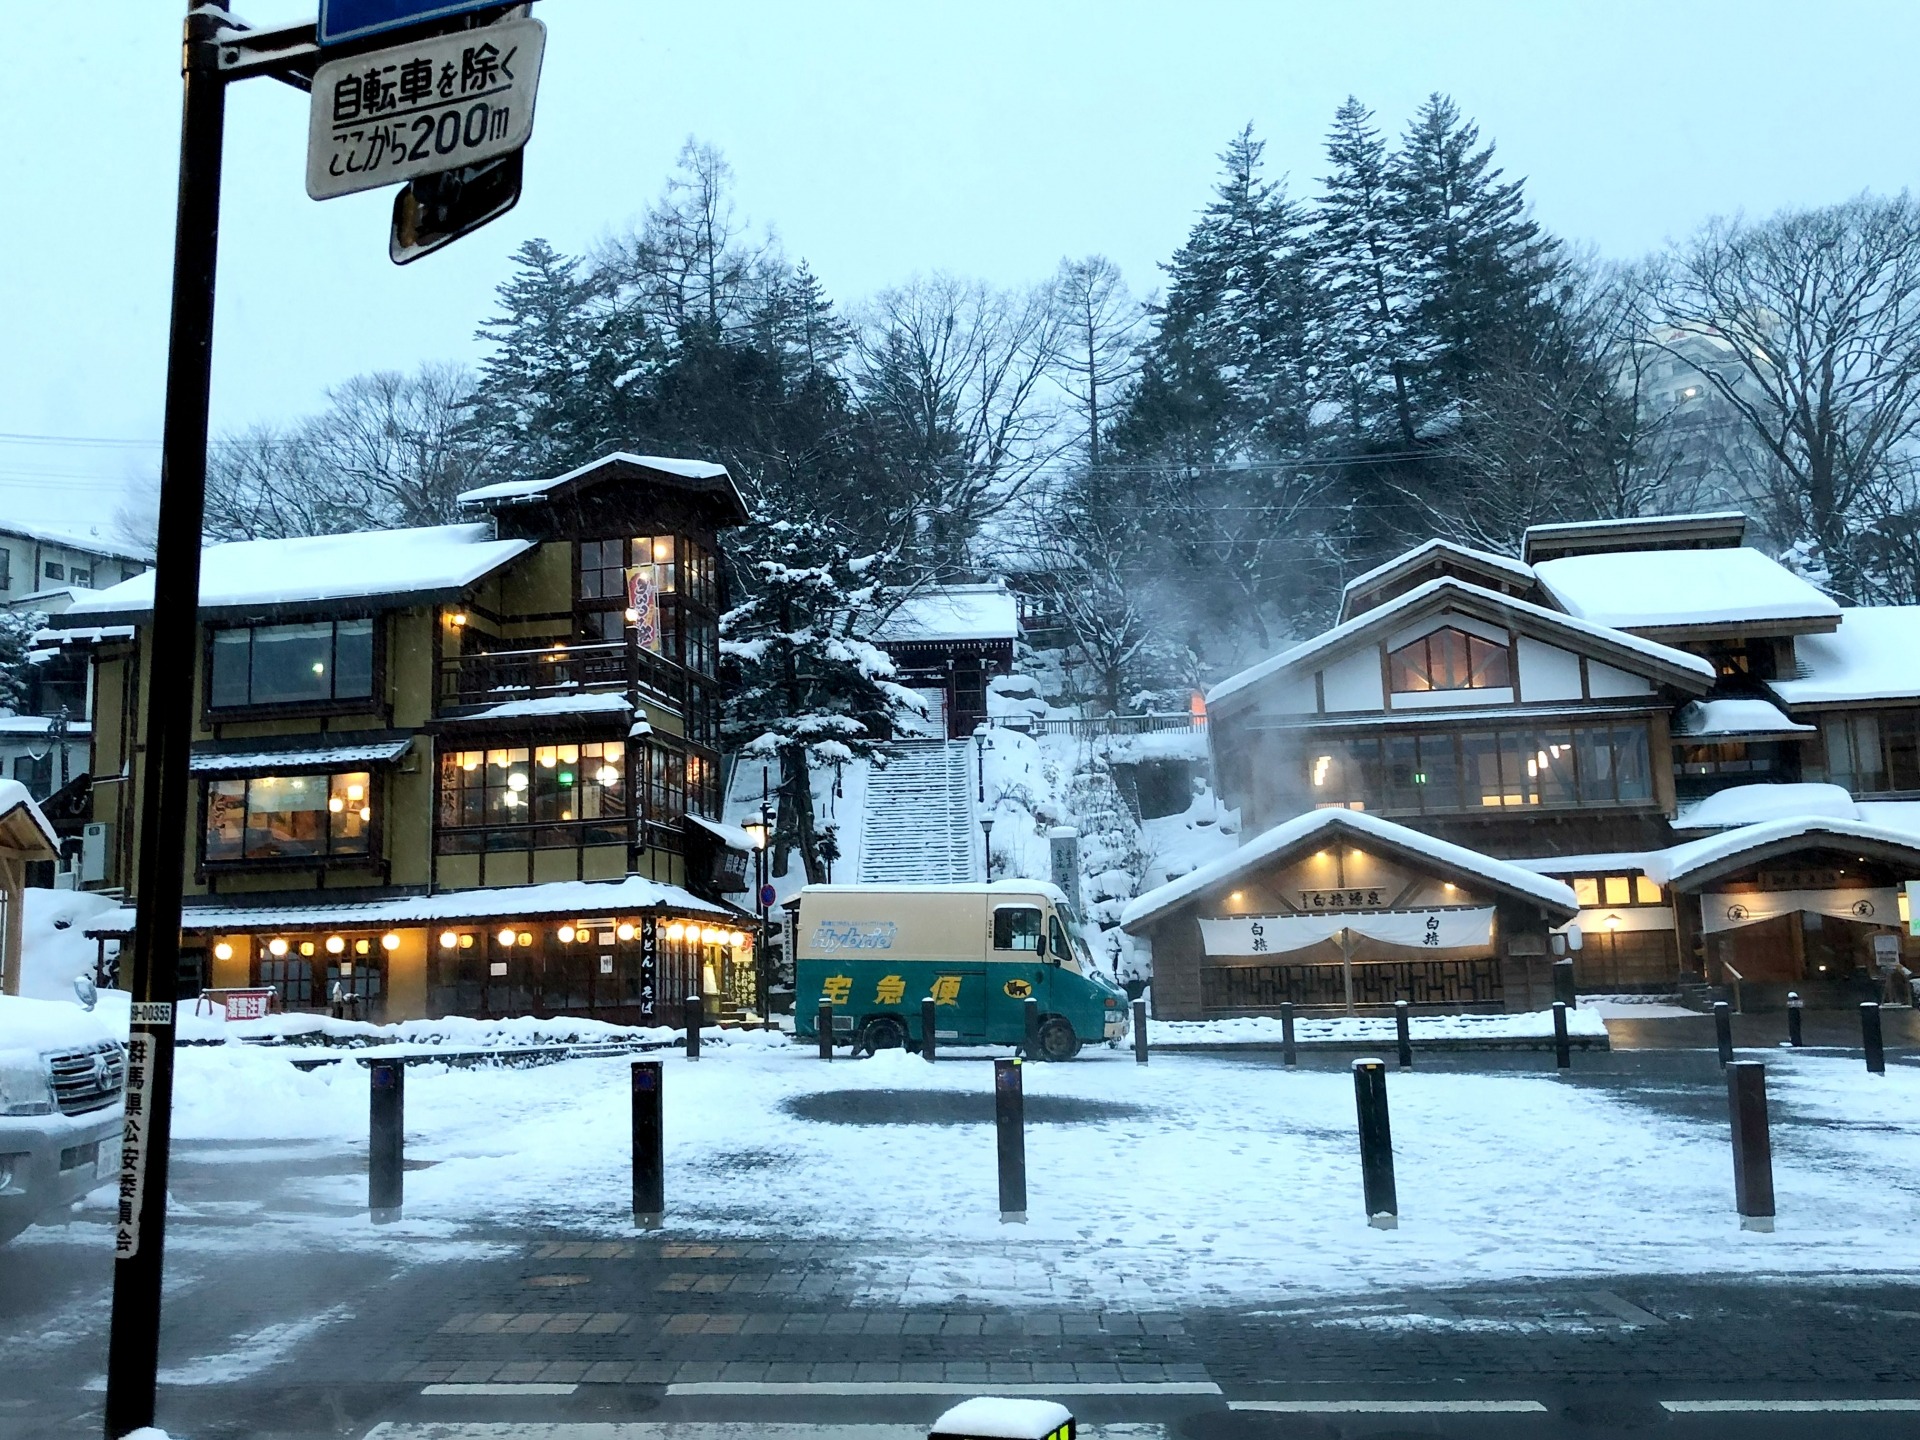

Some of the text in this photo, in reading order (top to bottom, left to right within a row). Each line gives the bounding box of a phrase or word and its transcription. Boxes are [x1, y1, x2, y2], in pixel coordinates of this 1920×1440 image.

[333, 42, 518, 122] 自転車を除く
[329, 102, 510, 177] ここから200m
[641, 922, 655, 1015] うどん・そば
[809, 927, 898, 953] Hybrid
[821, 974, 963, 1006] 宅急便
[116, 1040, 148, 1253] 群馬県公安委員会
